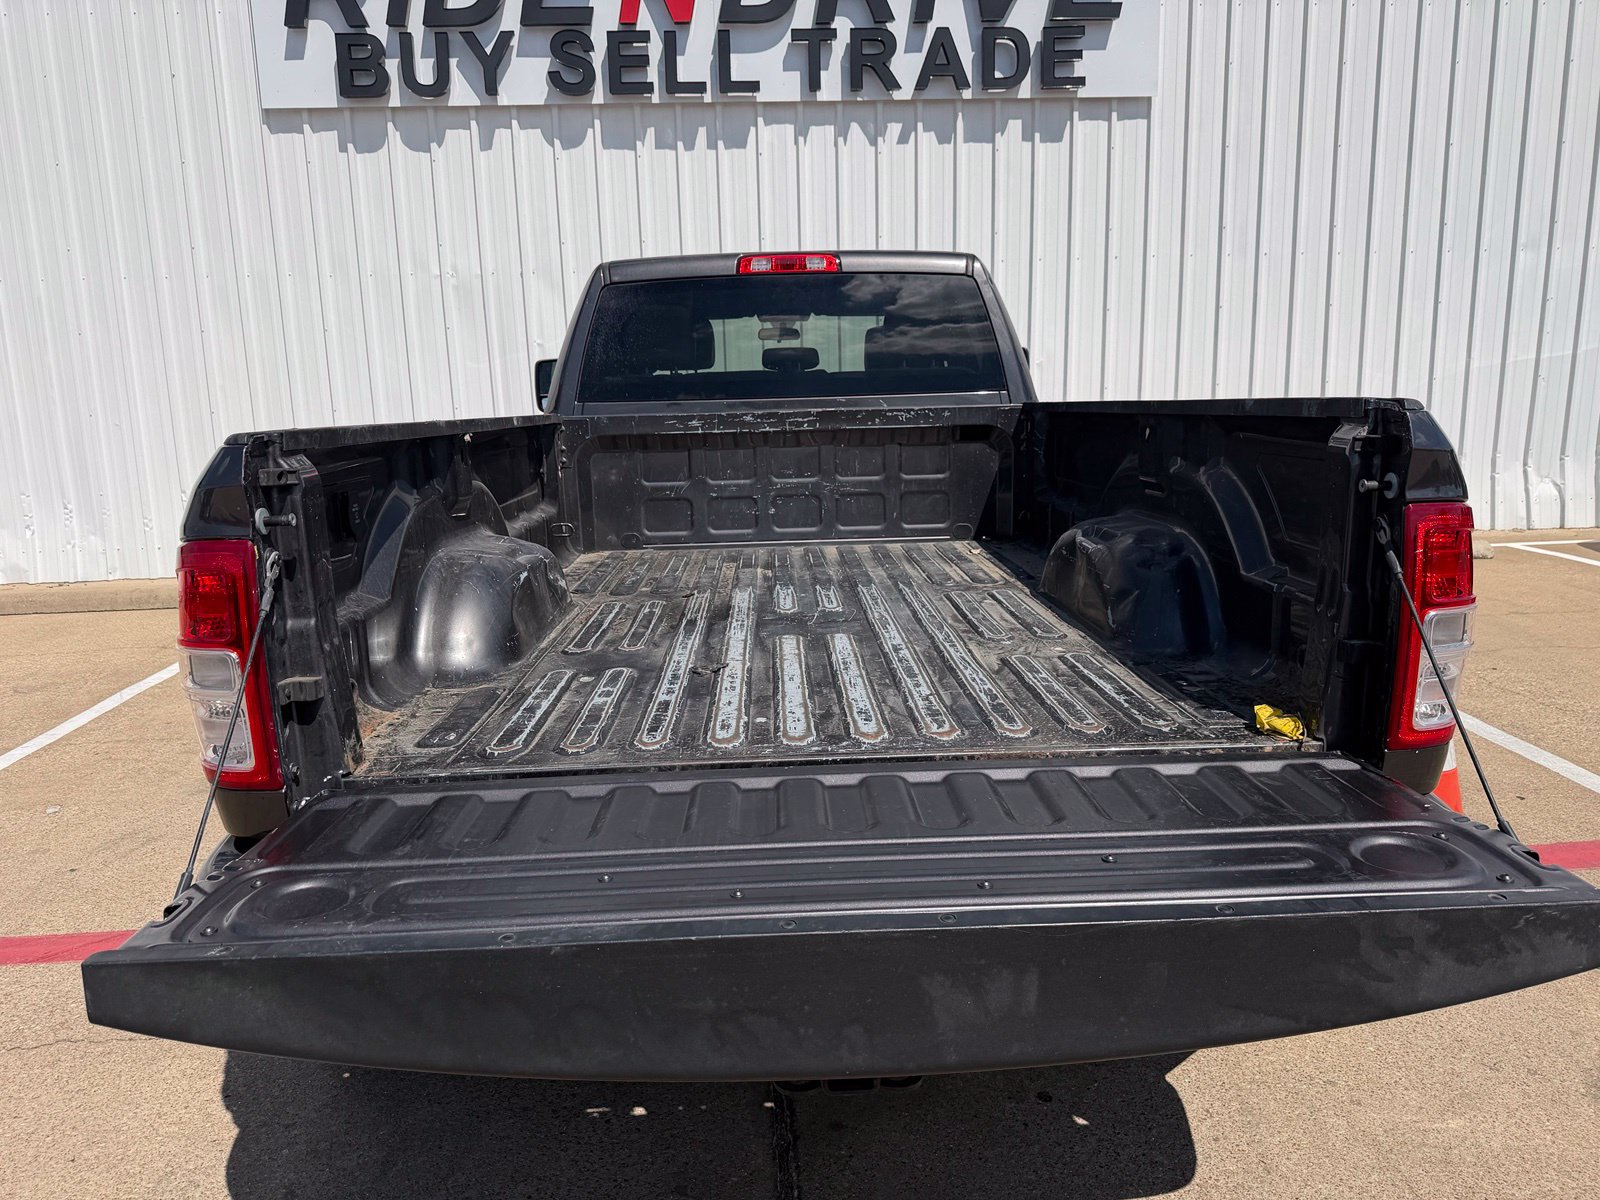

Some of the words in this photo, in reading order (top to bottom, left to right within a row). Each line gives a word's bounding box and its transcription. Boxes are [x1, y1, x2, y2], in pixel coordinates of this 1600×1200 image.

[335, 30, 515, 99] BUY
[547, 29, 760, 97] SELL
[791, 25, 1086, 93] TRADE
